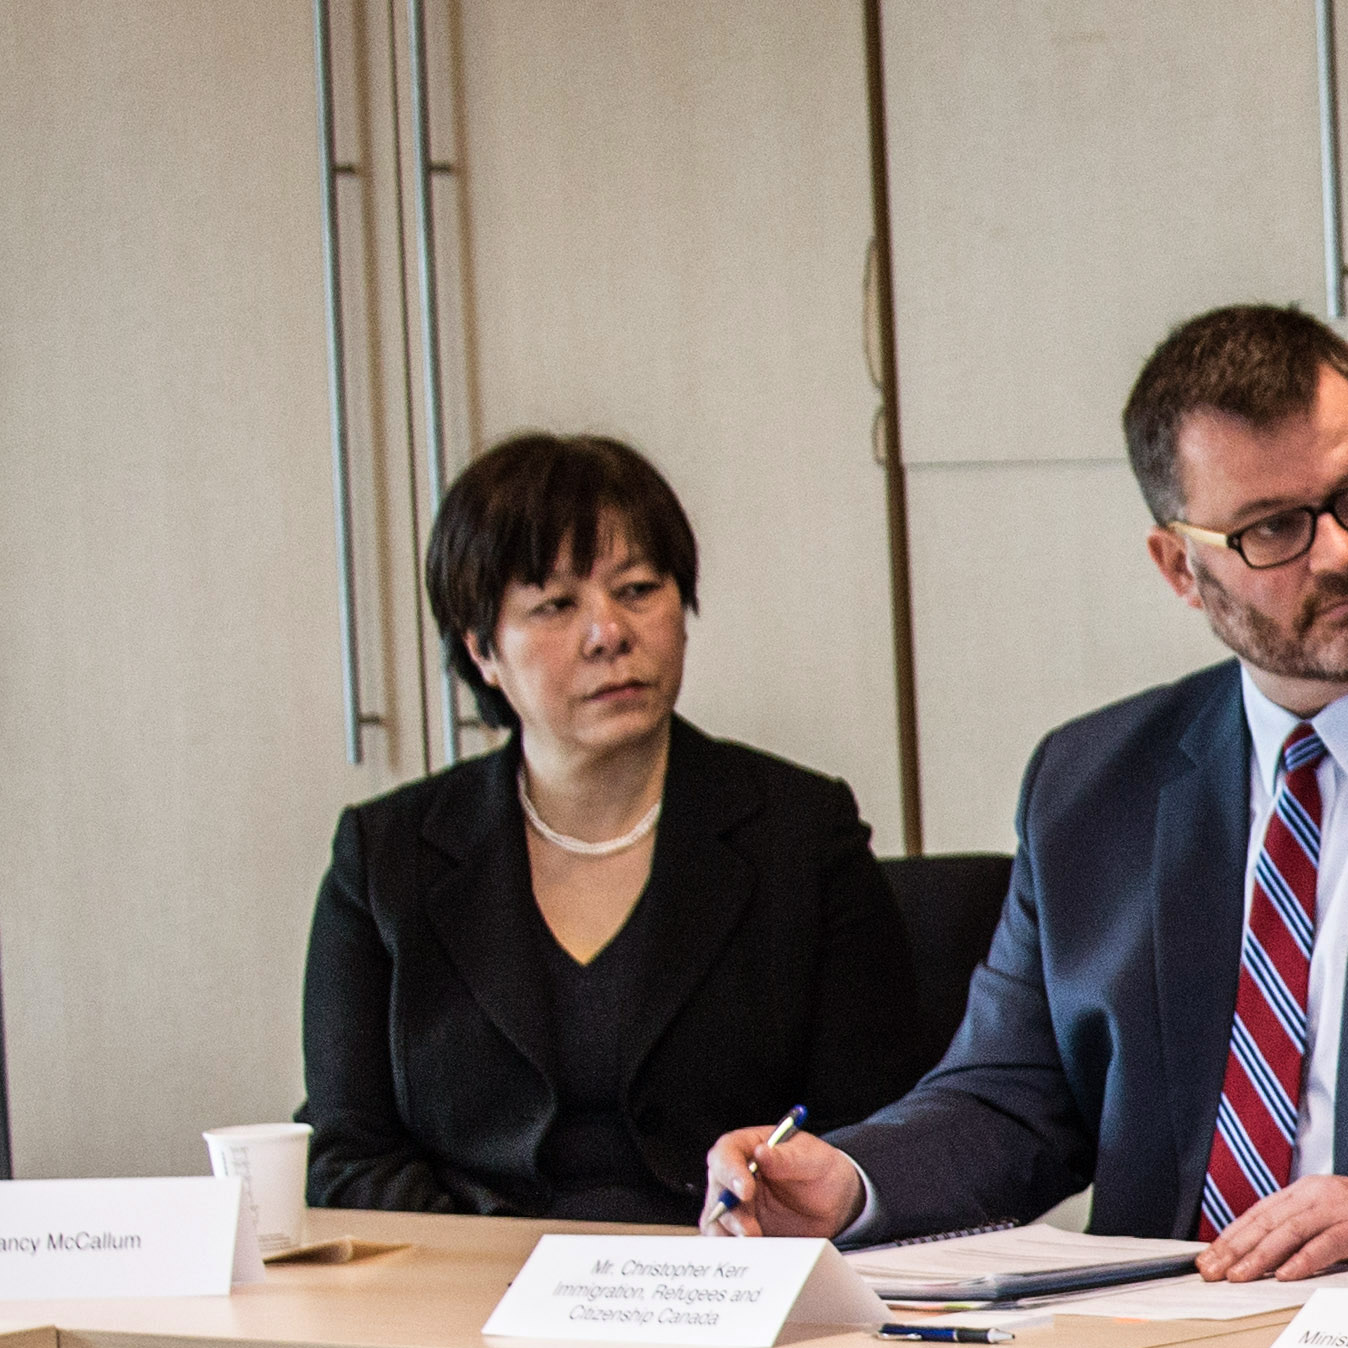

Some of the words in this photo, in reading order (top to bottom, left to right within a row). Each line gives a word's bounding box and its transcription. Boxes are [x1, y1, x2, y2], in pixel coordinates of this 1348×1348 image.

[0, 1237, 40, 1256] ancy
[46, 1231, 142, 1251] McCallum
[591, 1259, 615, 1276] Mr.
[621, 1258, 711, 1280] Christopher
[713, 1261, 750, 1279] Kerr
[552, 1280, 645, 1302] Immigration,
[652, 1283, 728, 1305] Refugees
[729, 1287, 763, 1303] and
[568, 1303, 655, 1326] Citizenship
[657, 1307, 720, 1326] Canada
